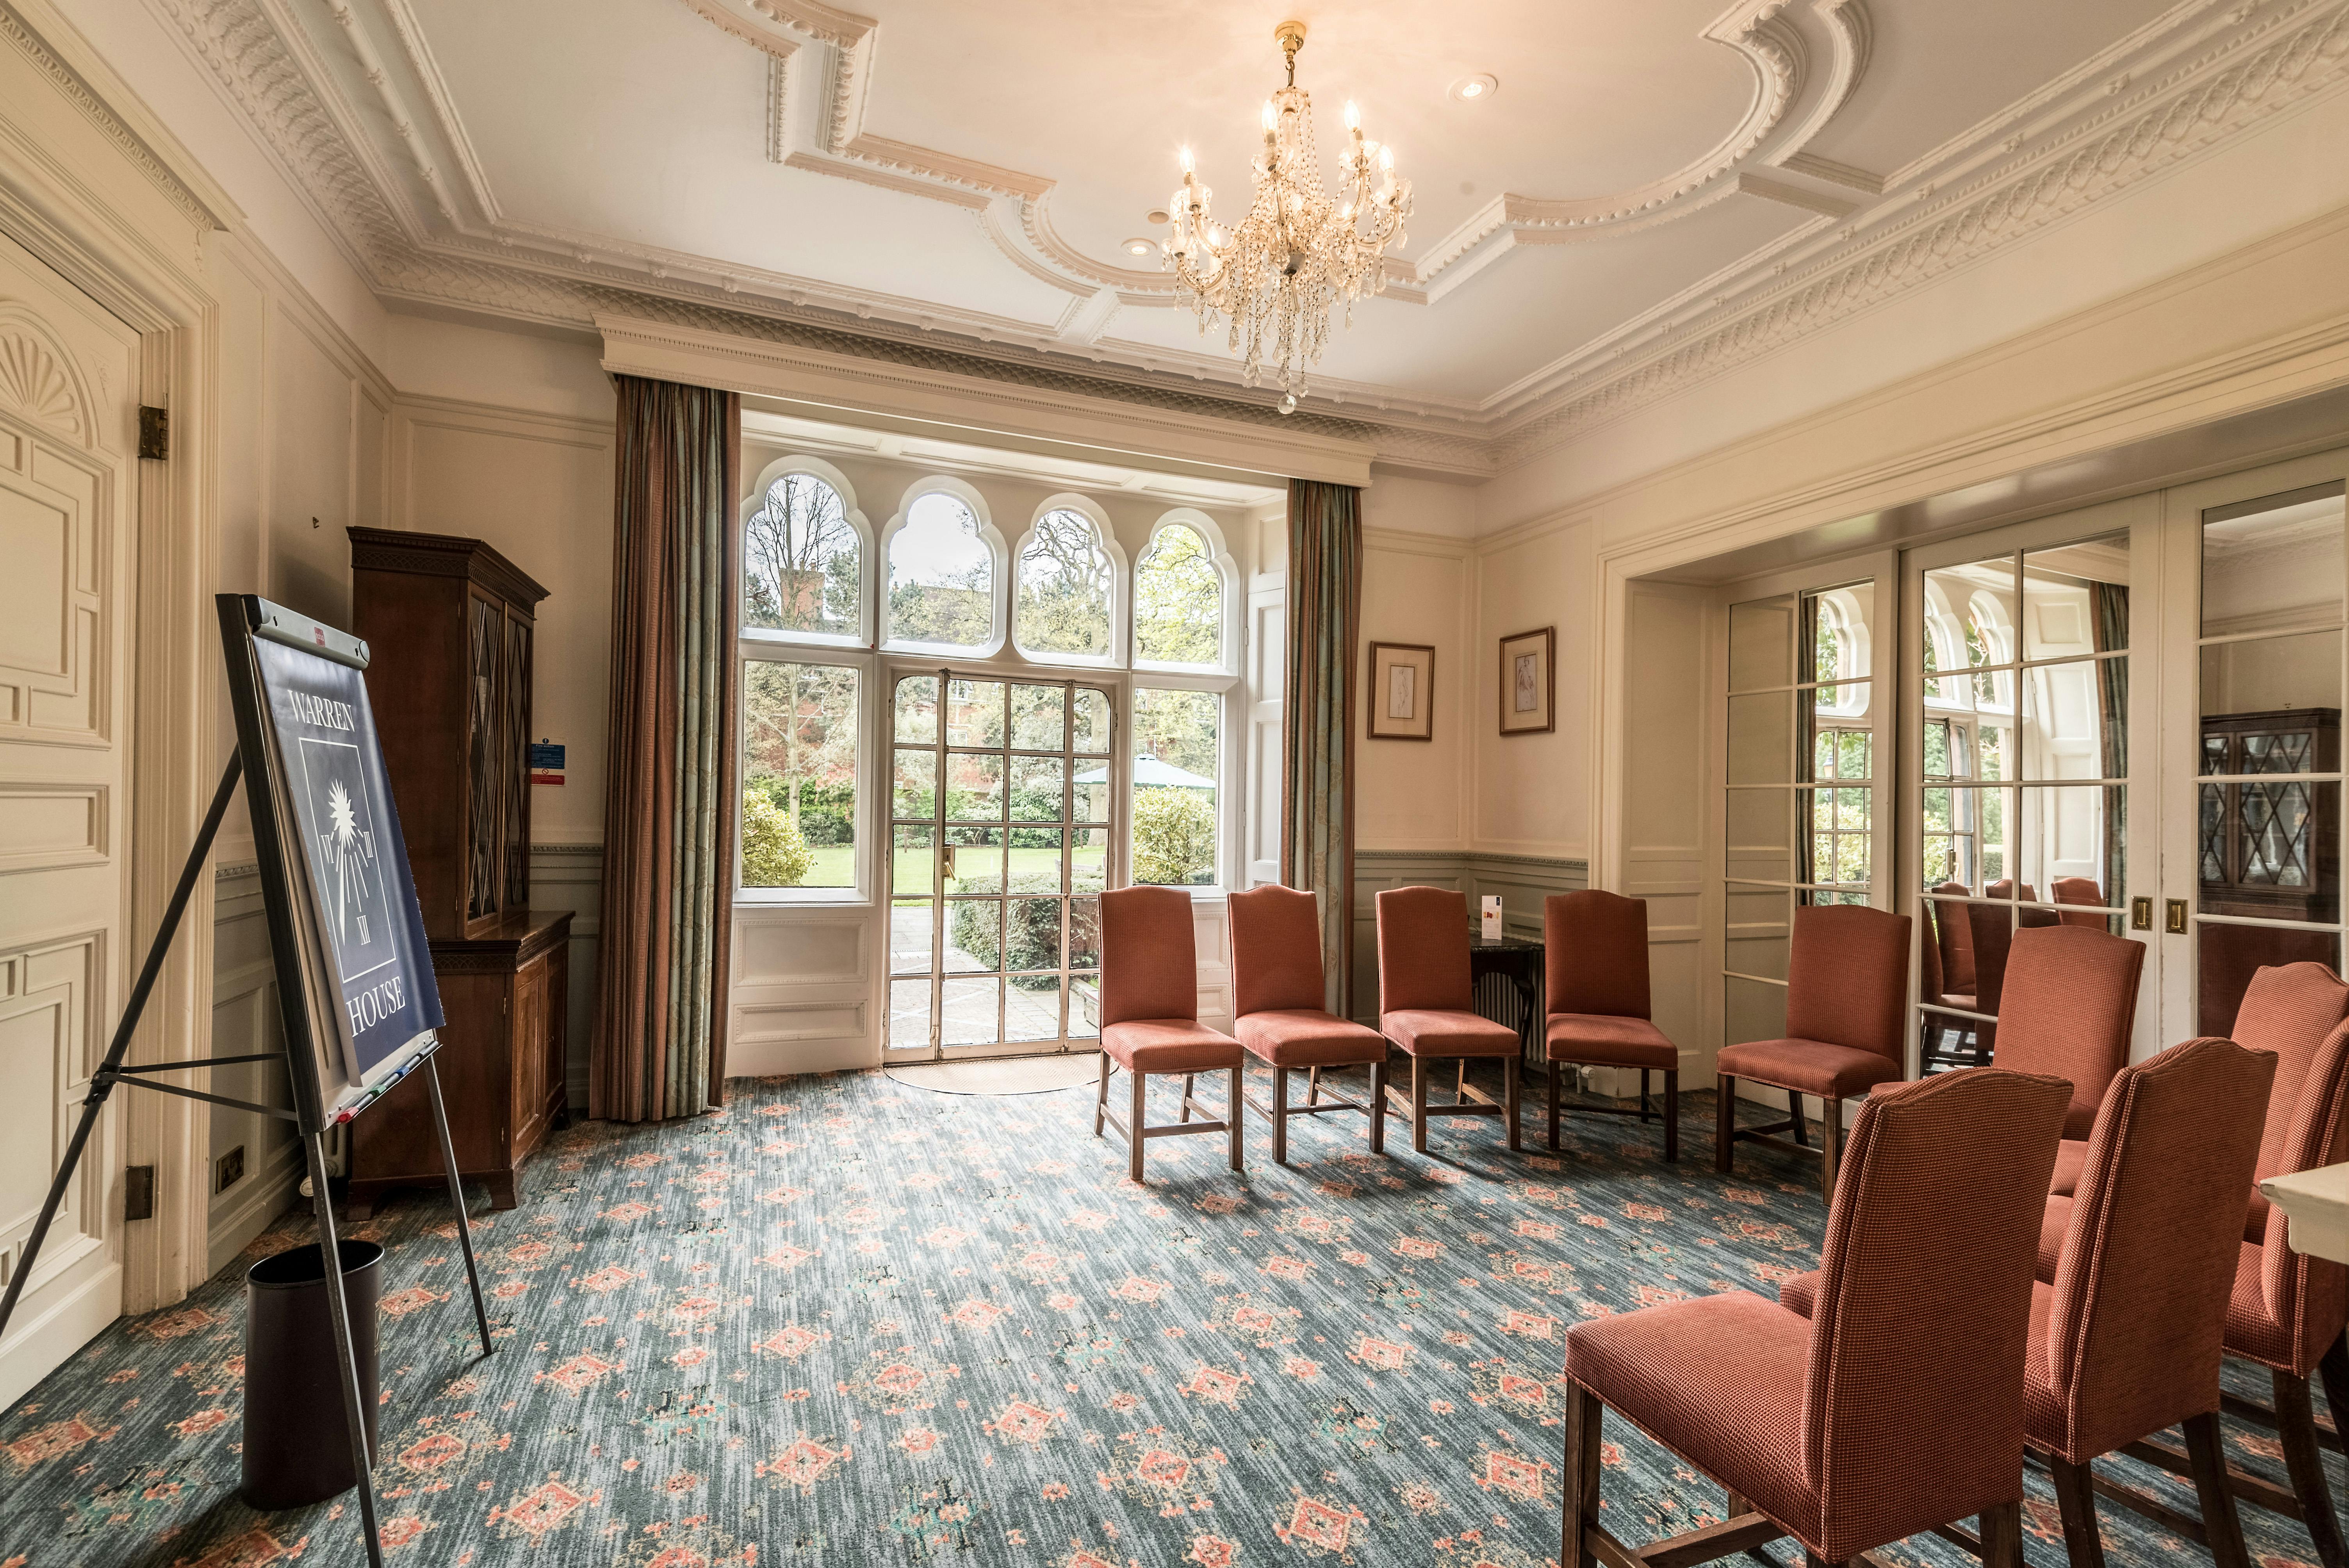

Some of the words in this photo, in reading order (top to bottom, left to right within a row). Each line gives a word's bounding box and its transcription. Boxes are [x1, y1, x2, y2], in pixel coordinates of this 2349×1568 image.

[287, 690, 355, 732] WARREN
[321, 835, 334, 864] VI
[364, 831, 373, 858] III
[356, 915, 371, 945] XII
[346, 976, 406, 1038] HOUSE
